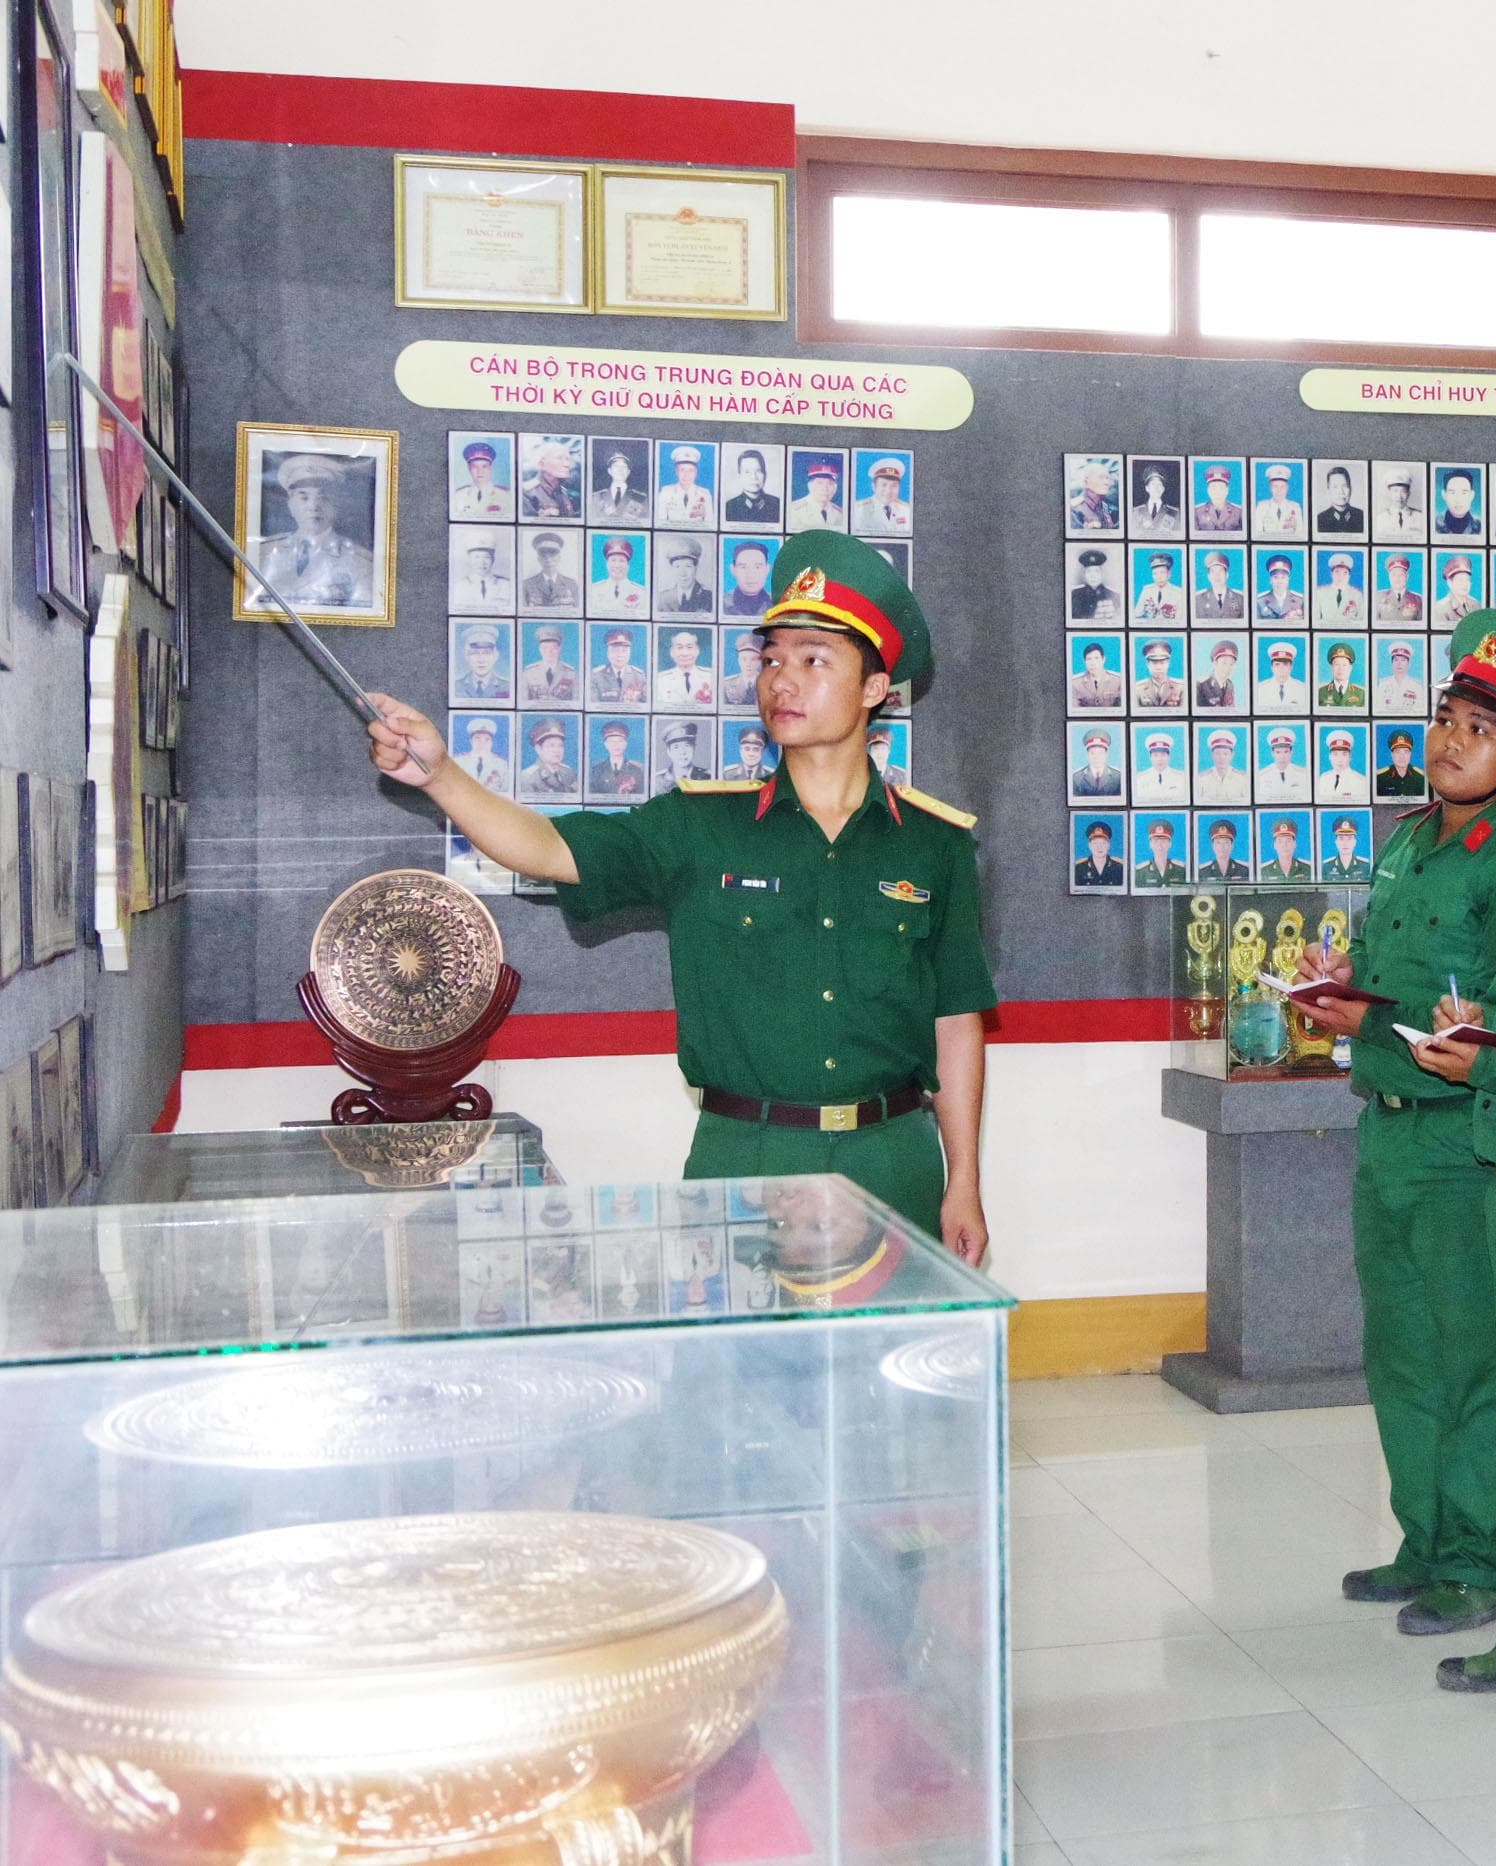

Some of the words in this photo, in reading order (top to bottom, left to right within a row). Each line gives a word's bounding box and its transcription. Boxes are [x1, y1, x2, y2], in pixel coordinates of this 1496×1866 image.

[470, 353, 518, 376] CÁN
[527, 356, 560, 380] BỘ
[566, 361, 647, 381] TRONG
[654, 366, 733, 386] TRUNG
[740, 367, 803, 390] ĐOÀN
[810, 373, 856, 392] QUA
[862, 373, 908, 394] CÁC
[1361, 383, 1401, 400] BAN
[1408, 379, 1442, 402] CHỈ
[1449, 387, 1487, 403] HUY
[490, 383, 545, 404] THỜI
[553, 385, 583, 405] KỲ
[591, 387, 632, 408] GIỮ
[638, 390, 701, 411] QUÂN
[709, 393, 757, 414] HÀM
[765, 393, 810, 416] CẤP
[817, 398, 893, 420] TƯỚNG
